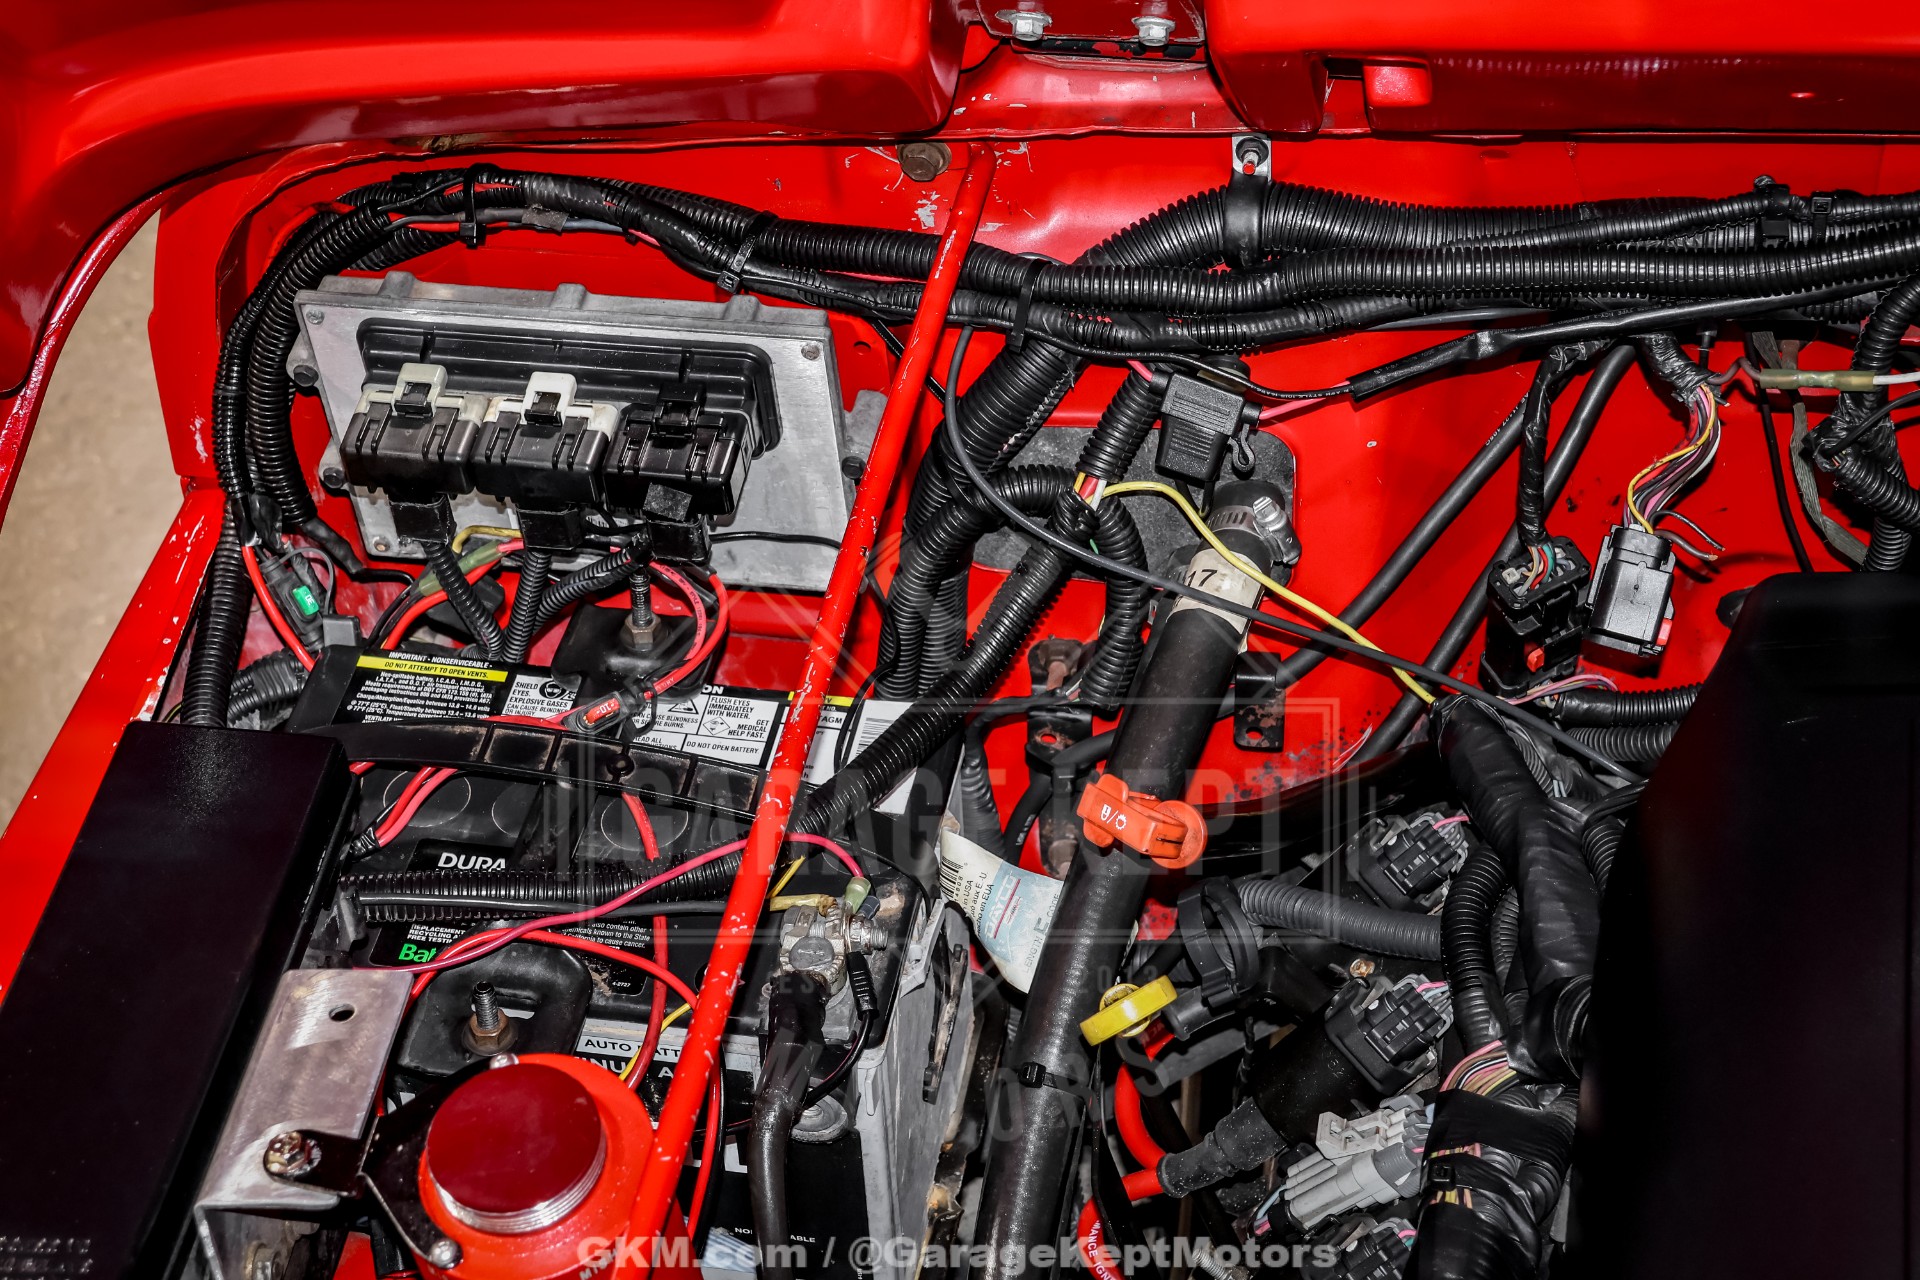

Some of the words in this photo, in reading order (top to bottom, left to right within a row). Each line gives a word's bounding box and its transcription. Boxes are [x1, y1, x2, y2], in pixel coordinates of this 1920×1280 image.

[388, 651, 427, 662] IMPORTANT
[431, 656, 489, 669] NONSERVICEABLE
[408, 663, 438, 673] ATTEMPT
[448, 667, 466, 676] OPEN
[467, 669, 489, 679] VENTS.
[514, 681, 539, 690] SHIELD
[512, 688, 531, 697] EYES.
[509, 696, 546, 706] EXPLOSIVE
[546, 700, 569, 709] GASES
[711, 697, 732, 706] FLUSH
[733, 698, 751, 707] EYES
[520, 704, 539, 712] CAUSE
[708, 704, 755, 714] IMMEDIATELY
[665, 715, 699, 724] BLINDNESS
[706, 709, 725, 718] WITH
[726, 711, 751, 720] WATER.
[663, 721, 685, 729] BURNS.
[737, 723, 768, 733] MEDICAL
[728, 729, 745, 737] HELP
[746, 731, 765, 740] FAST.
[686, 740, 696, 748] DO
[711, 743, 730, 752] OPEN
[963, 880, 974, 898] USA
[982, 883, 995, 901] EUA
[972, 889, 980, 905] aux
[979, 901, 987, 912] en
[409, 929, 452, 939] RECYCLING
[606, 923, 629, 931] contain
[629, 926, 647, 934] other
[407, 934, 427, 942] FREE
[592, 928, 614, 937] known
[633, 933, 651, 942] State
[604, 938, 622, 946] cause
[623, 941, 646, 949] cancer.
[1023, 935, 1043, 974] LENGTH
[584, 1039, 631, 1052] AUTO
